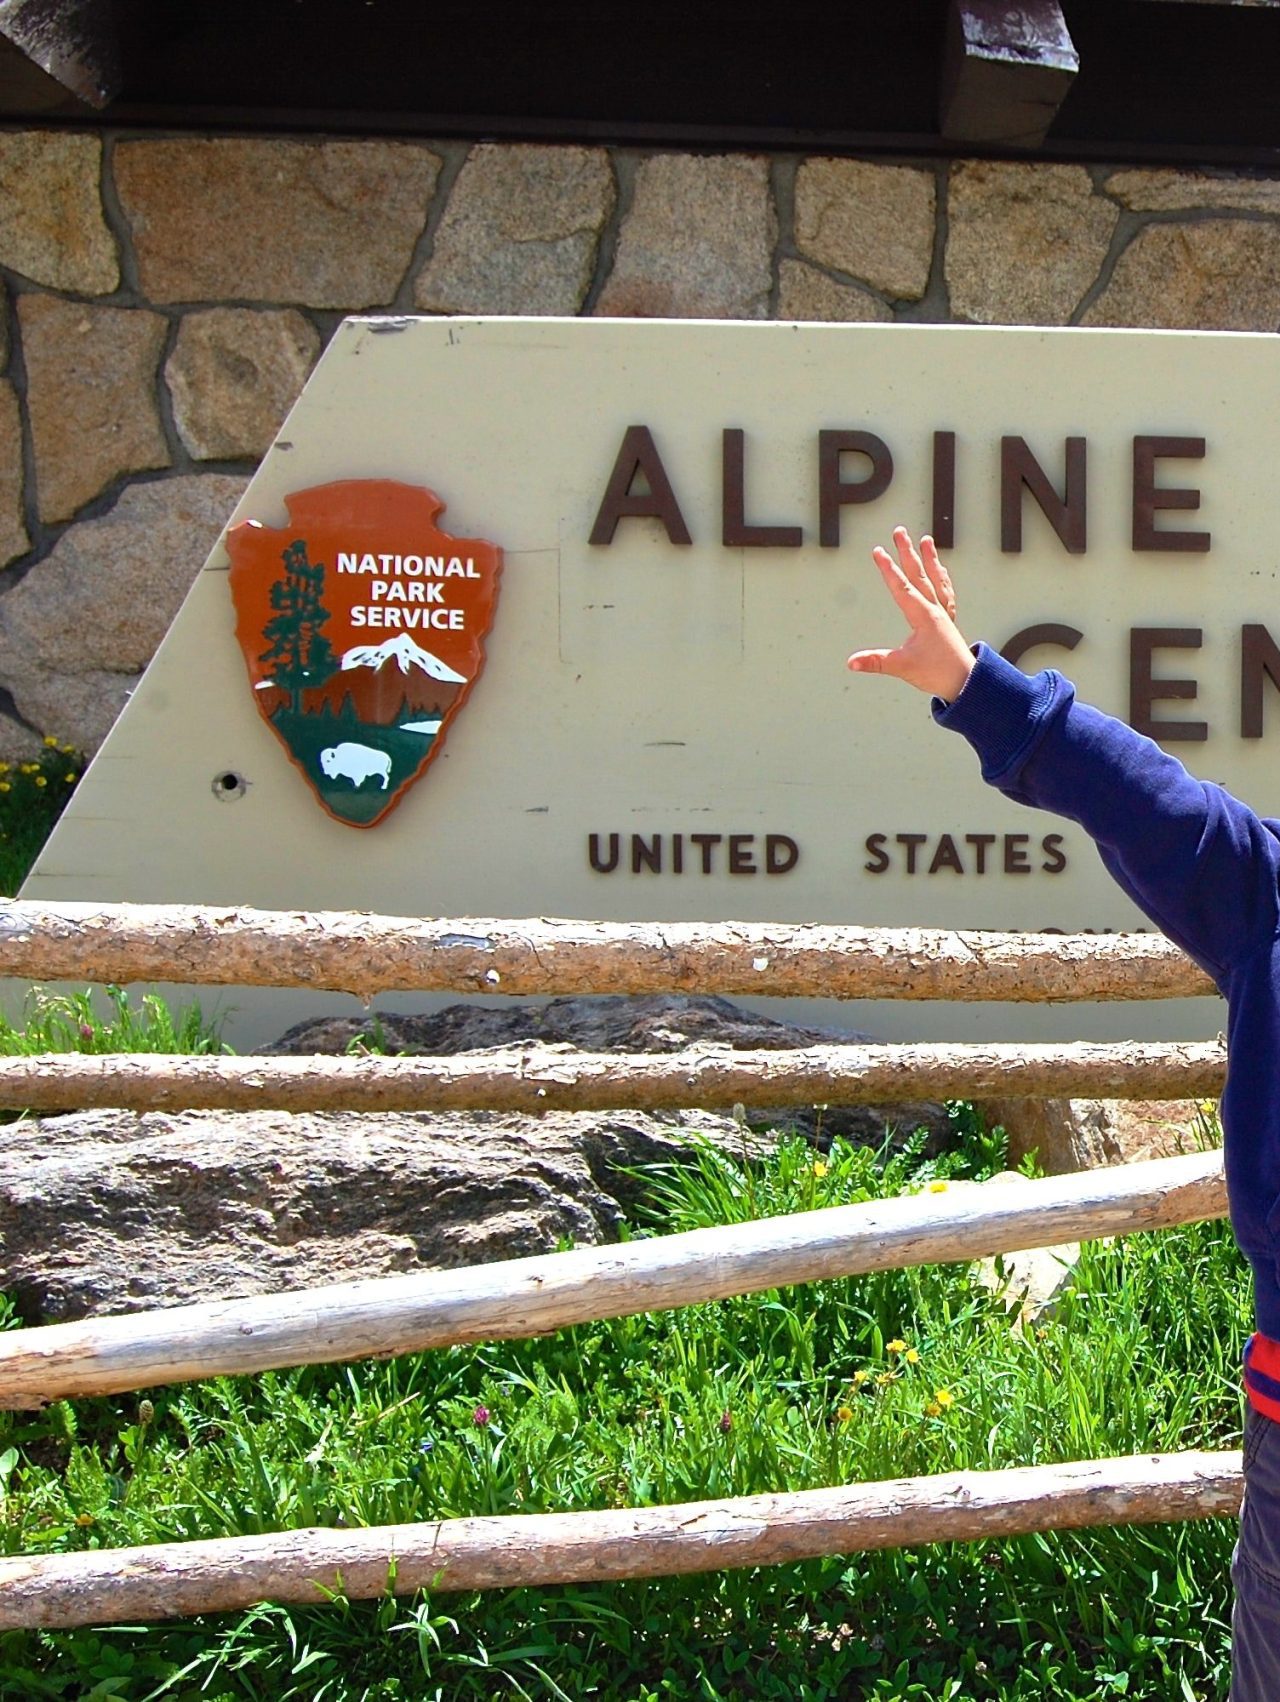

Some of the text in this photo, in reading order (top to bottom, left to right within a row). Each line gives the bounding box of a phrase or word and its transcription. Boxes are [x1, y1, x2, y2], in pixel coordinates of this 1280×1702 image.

[588, 425, 1211, 553] ALPINE
[337, 552, 480, 577] NATIONAL
[371, 580, 444, 603] PARK
[350, 606, 464, 630] SERVICE
[588, 833, 800, 874] UNITED
[864, 833, 1067, 874] STATES
